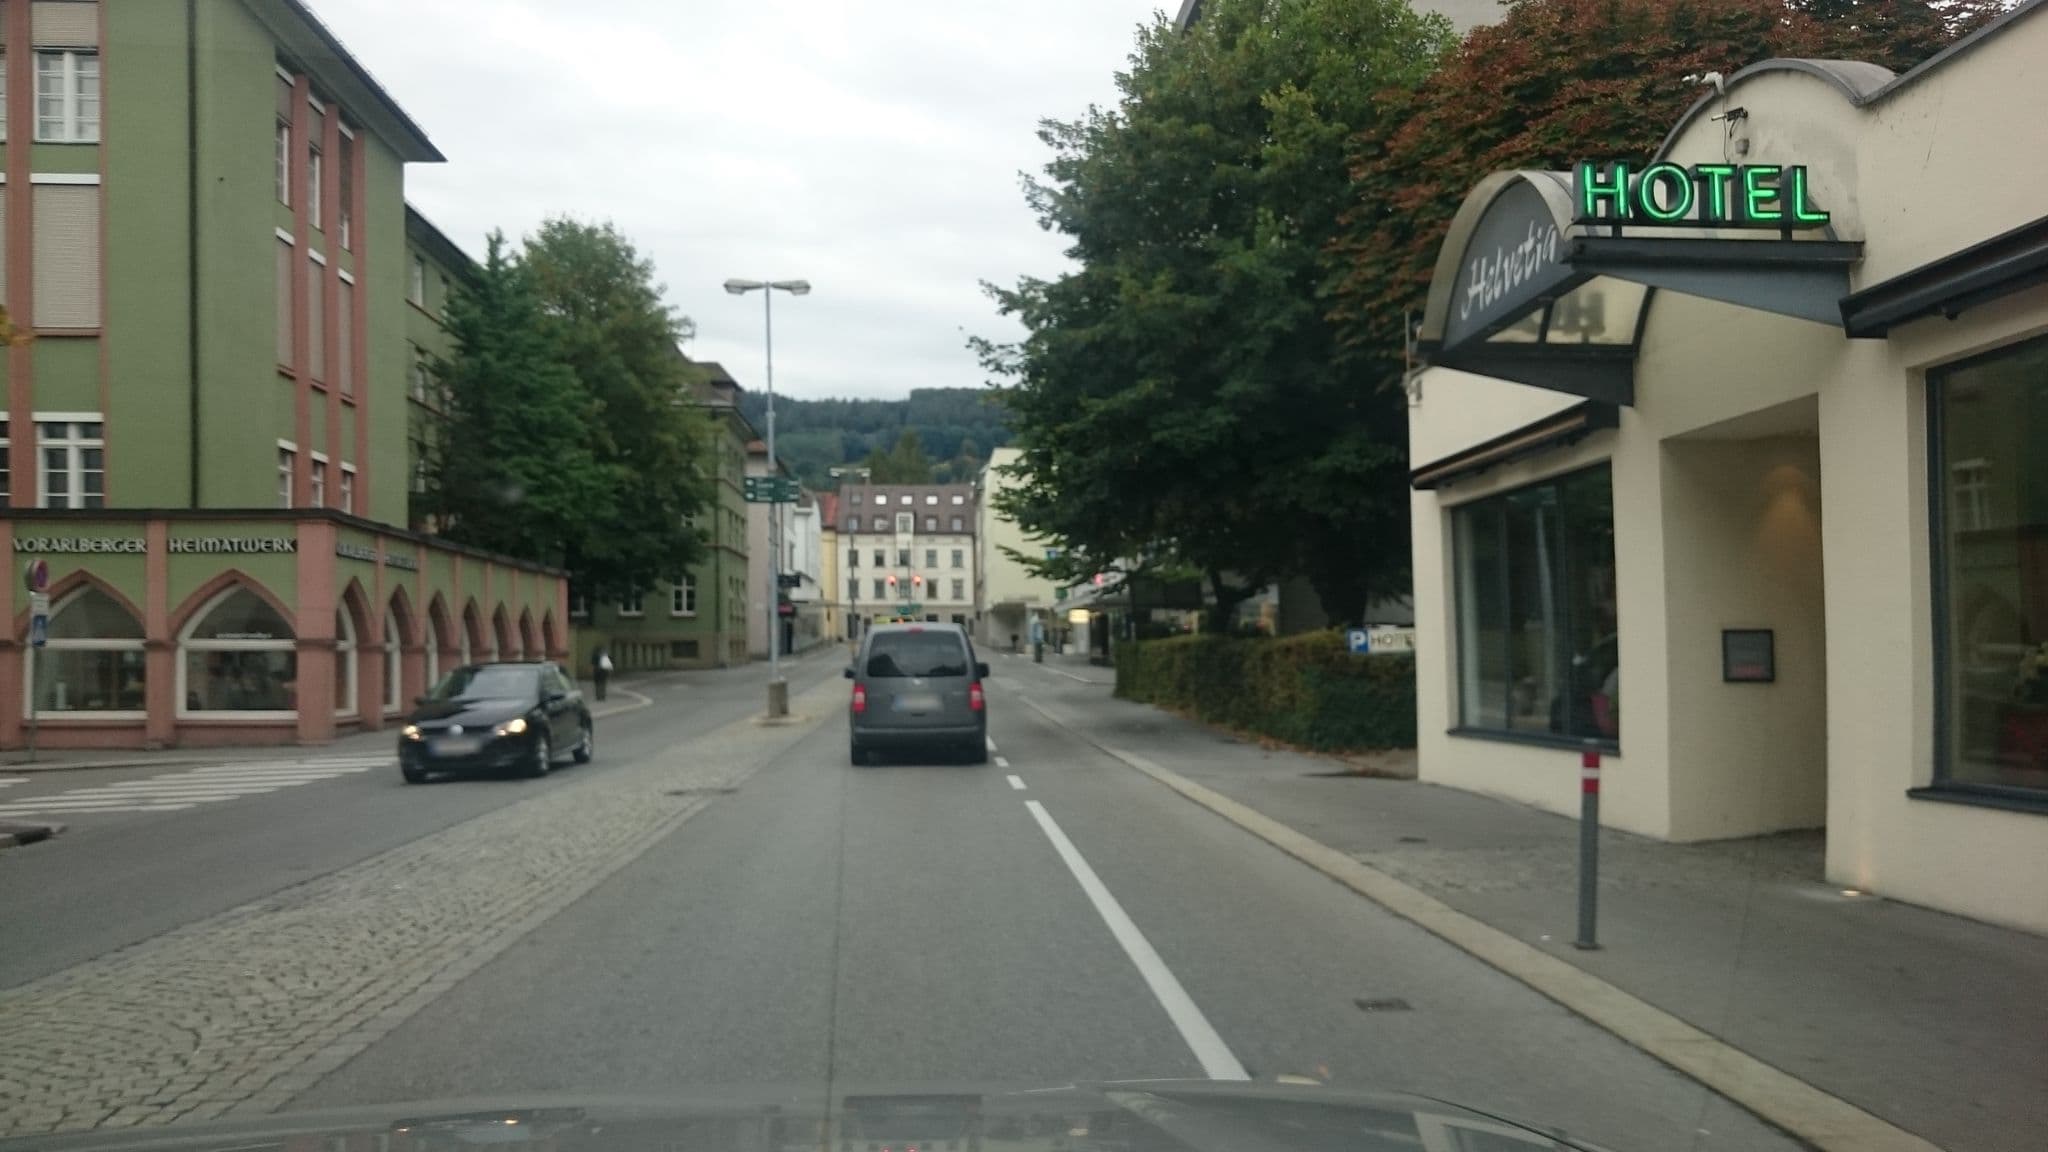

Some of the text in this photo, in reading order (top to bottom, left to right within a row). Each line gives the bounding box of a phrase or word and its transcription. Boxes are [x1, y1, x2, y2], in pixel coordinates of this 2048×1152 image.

[1577, 160, 1830, 222] HOTEL
[1461, 221, 1557, 320] Helvetia
[12, 537, 295, 552] VORARLBERGER HEIMATWERK
[1350, 631, 1415, 651] P HOTE
